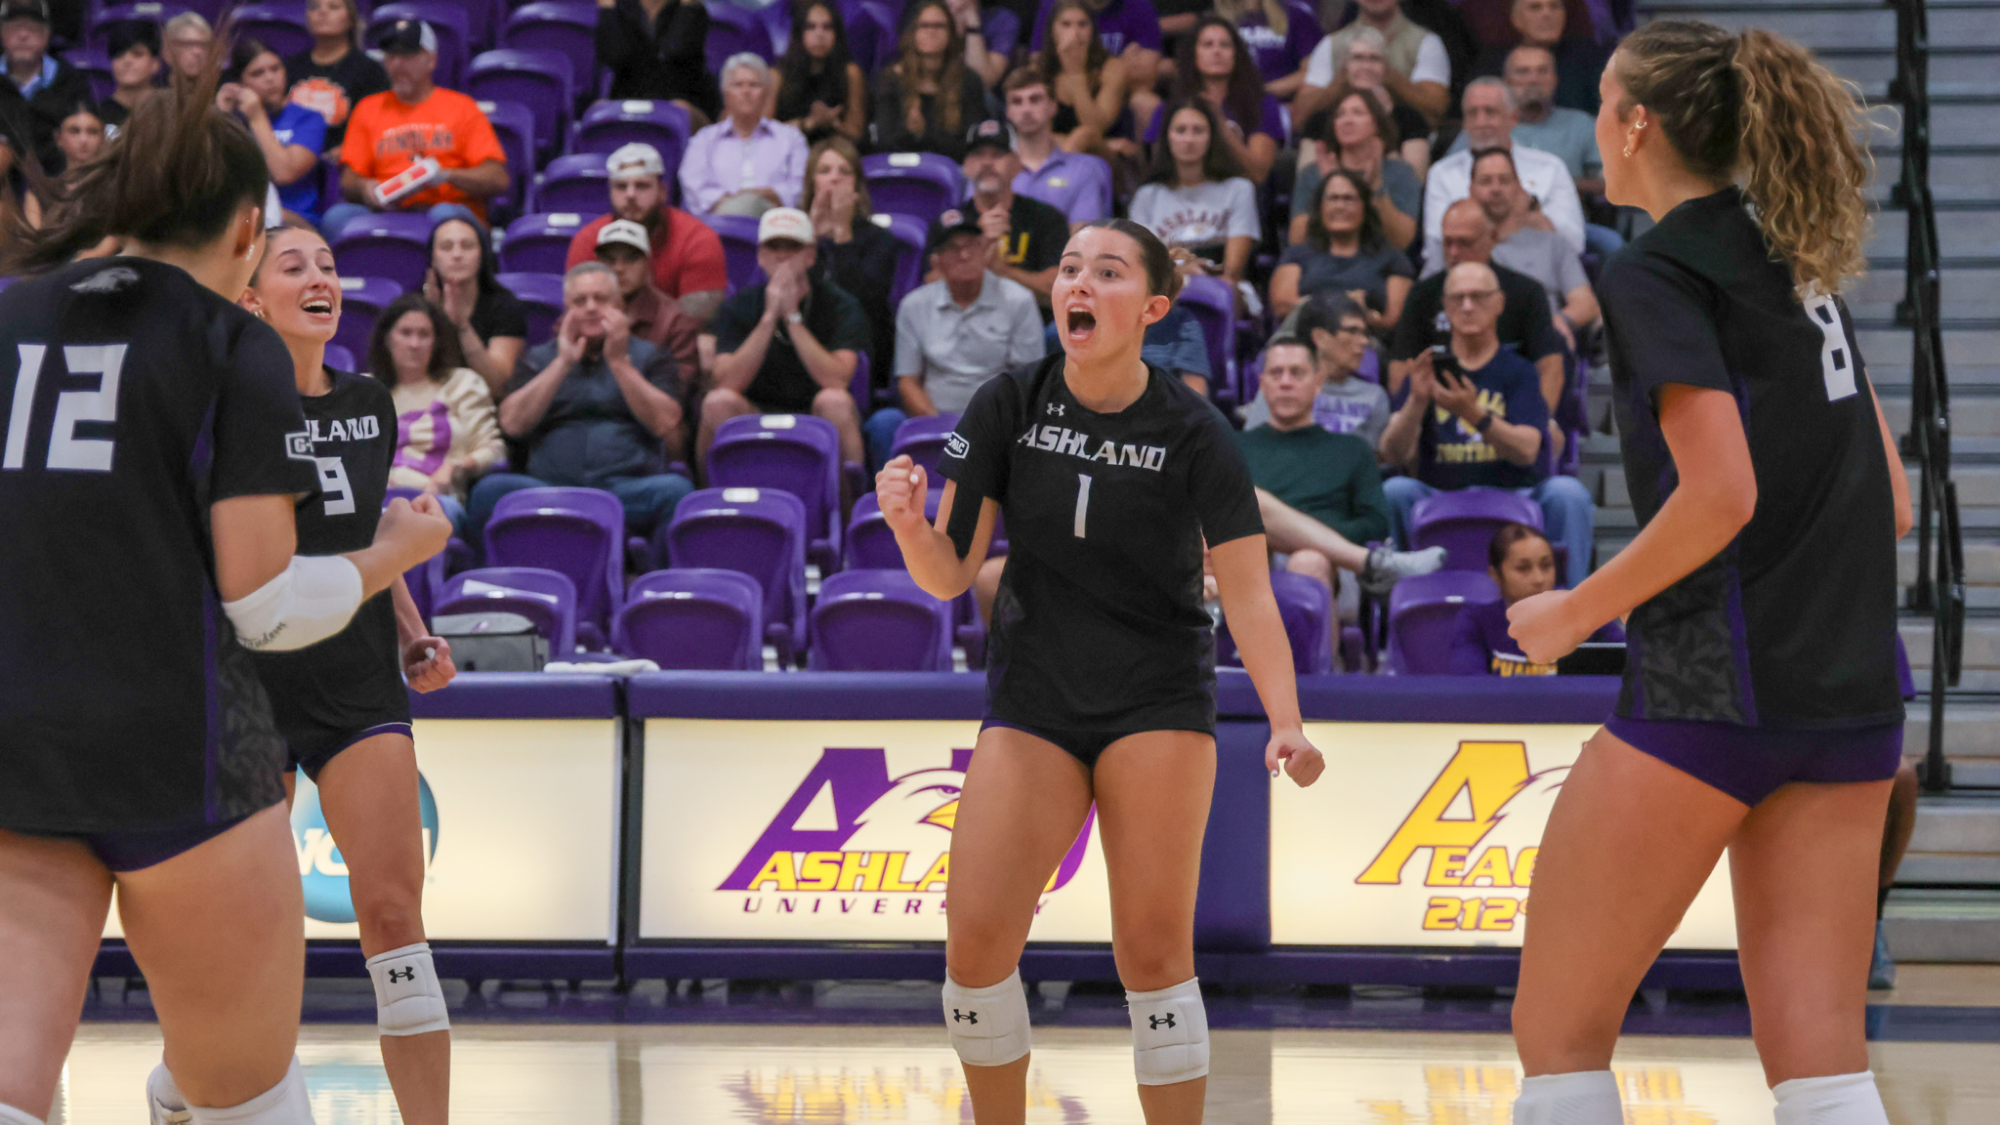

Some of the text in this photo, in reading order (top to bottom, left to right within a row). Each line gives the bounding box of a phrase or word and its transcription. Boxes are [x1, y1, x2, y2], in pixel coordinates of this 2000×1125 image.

[1794, 278, 1858, 402] 8
[2, 343, 129, 473] 12
[305, 415, 380, 442] LAND
[1017, 423, 1166, 472] ASHLAND
[1436, 443, 1497, 463] FOOTBA
[315, 456, 356, 516] 9
[1074, 473, 1093, 539] 1
[1424, 846, 1540, 887] EAG
